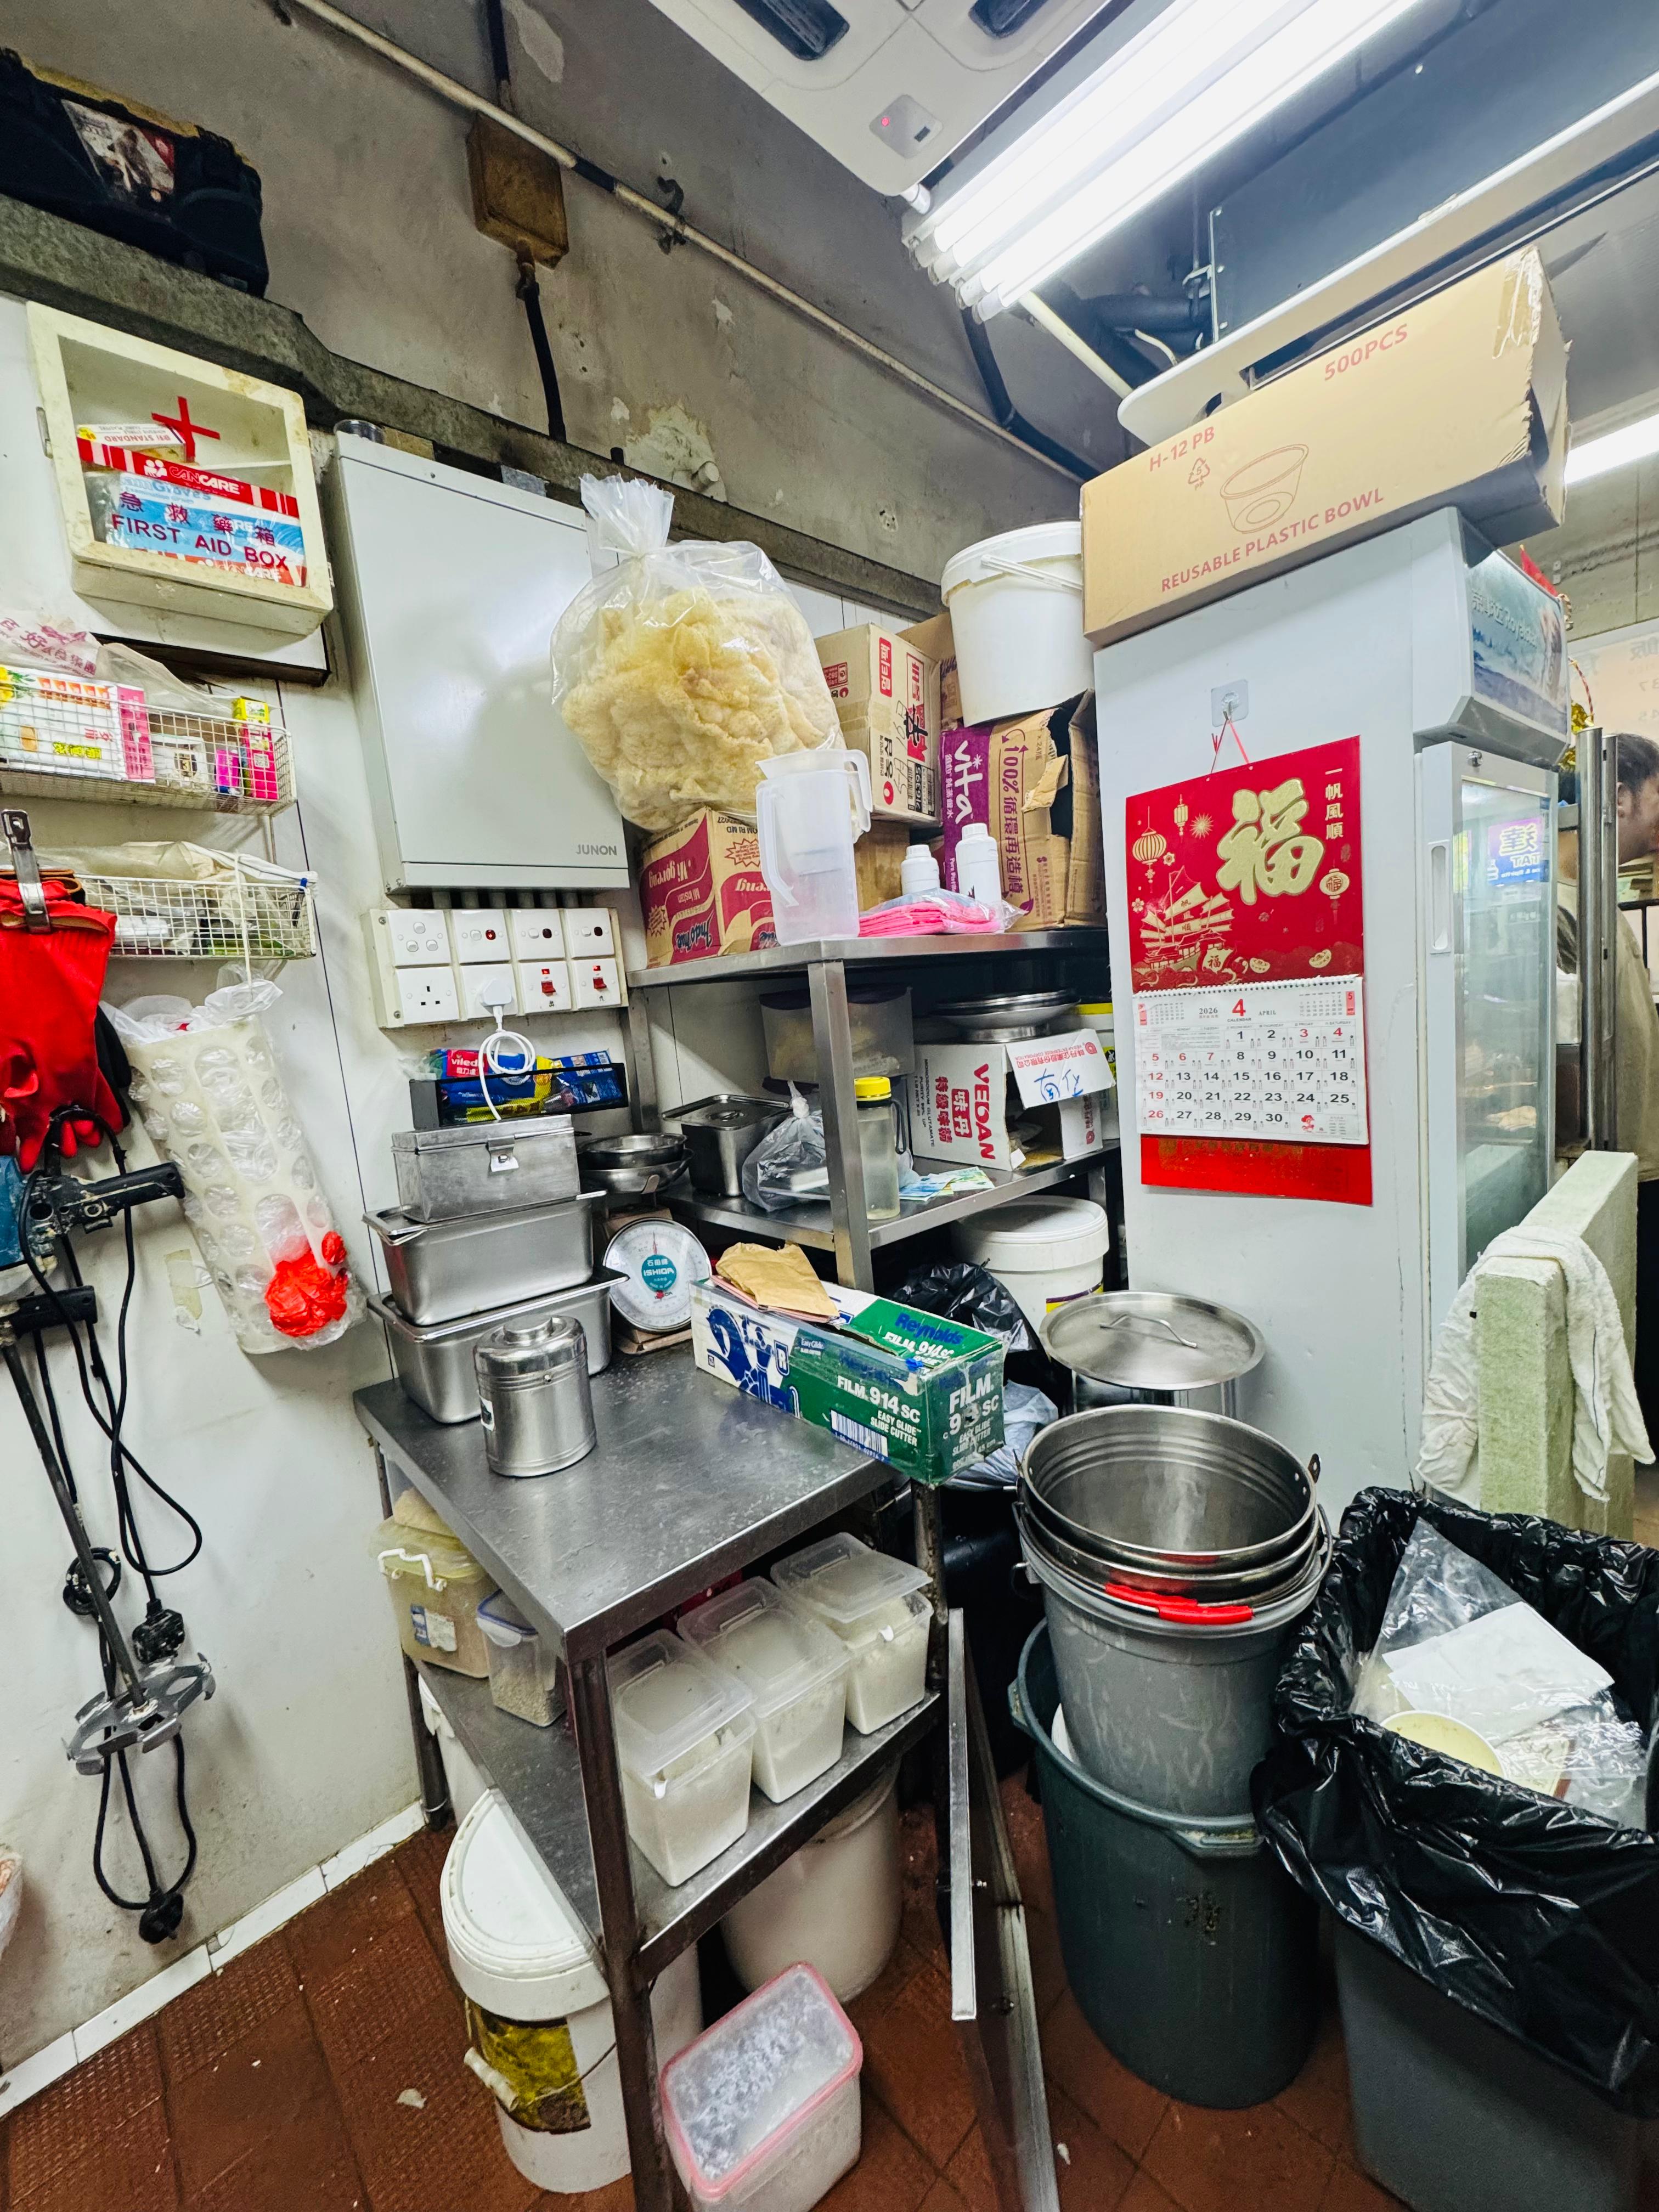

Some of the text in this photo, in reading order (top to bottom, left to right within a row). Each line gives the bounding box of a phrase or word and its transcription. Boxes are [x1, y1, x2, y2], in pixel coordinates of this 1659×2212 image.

[1324, 324, 1408, 381] 500PCS
[1149, 426, 1215, 472] H-12 PB
[119, 492, 275, 547] 急救藥箱
[110, 514, 289, 571] FIRST AID BOX
[1162, 488, 1384, 592] REUSABLE PLASTIC BOWL
[880, 644, 890, 690] 멀티팩
[904, 703, 928, 747] 辛
[884, 737, 893, 778] 농심
[954, 741, 983, 824] vita
[1324, 767, 1344, 840] 一帆風順
[575, 844, 617, 855] JUNON
[1216, 777, 1325, 905] 福
[649, 861, 675, 888] goreng
[678, 888, 700, 903] Mi Instan
[1207, 955, 1222, 968] 福
[1232, 998, 1246, 1017] 4
[1348, 992, 1353, 1000] 5
[1237, 1028, 1342, 1040] 1 2 3 4
[452, 1058, 484, 1067] viled
[1016, 1049, 1085, 1068] 味丹企業股份有限公司
[1179, 1053, 1187, 1061] 6
[1206, 1052, 1214, 1060] 7
[1237, 1052, 1245, 1060] 8
[1267, 1051, 1276, 1059] 9
[1295, 1049, 1314, 1059] 10
[1331, 1049, 1346, 1059] 11
[1148, 1071, 1348, 1081] 12 13 14 15 16 17 18
[935, 1076, 952, 1143] 特級味精
[953, 1091, 969, 1135] 味丹
[974, 1063, 995, 1160] VEDAN
[1176, 1092, 1192, 1101] 20
[1205, 1092, 1220, 1101] 21
[1234, 1092, 1251, 1102] 22
[1265, 1092, 1282, 1102] 23
[1296, 1093, 1315, 1102] 24
[1330, 1093, 1350, 1103] 25
[1148, 1110, 1283, 1122] 26 27 28 29 30
[895, 1312, 964, 1344] Reynolds
[870, 1386, 900, 1415] 914
[901, 1404, 921, 1423] SC
[877, 1409, 895, 1425] EASY
[982, 1395, 1000, 1417] SC
[870, 1417, 918, 1447] SLIDE CUTTER
